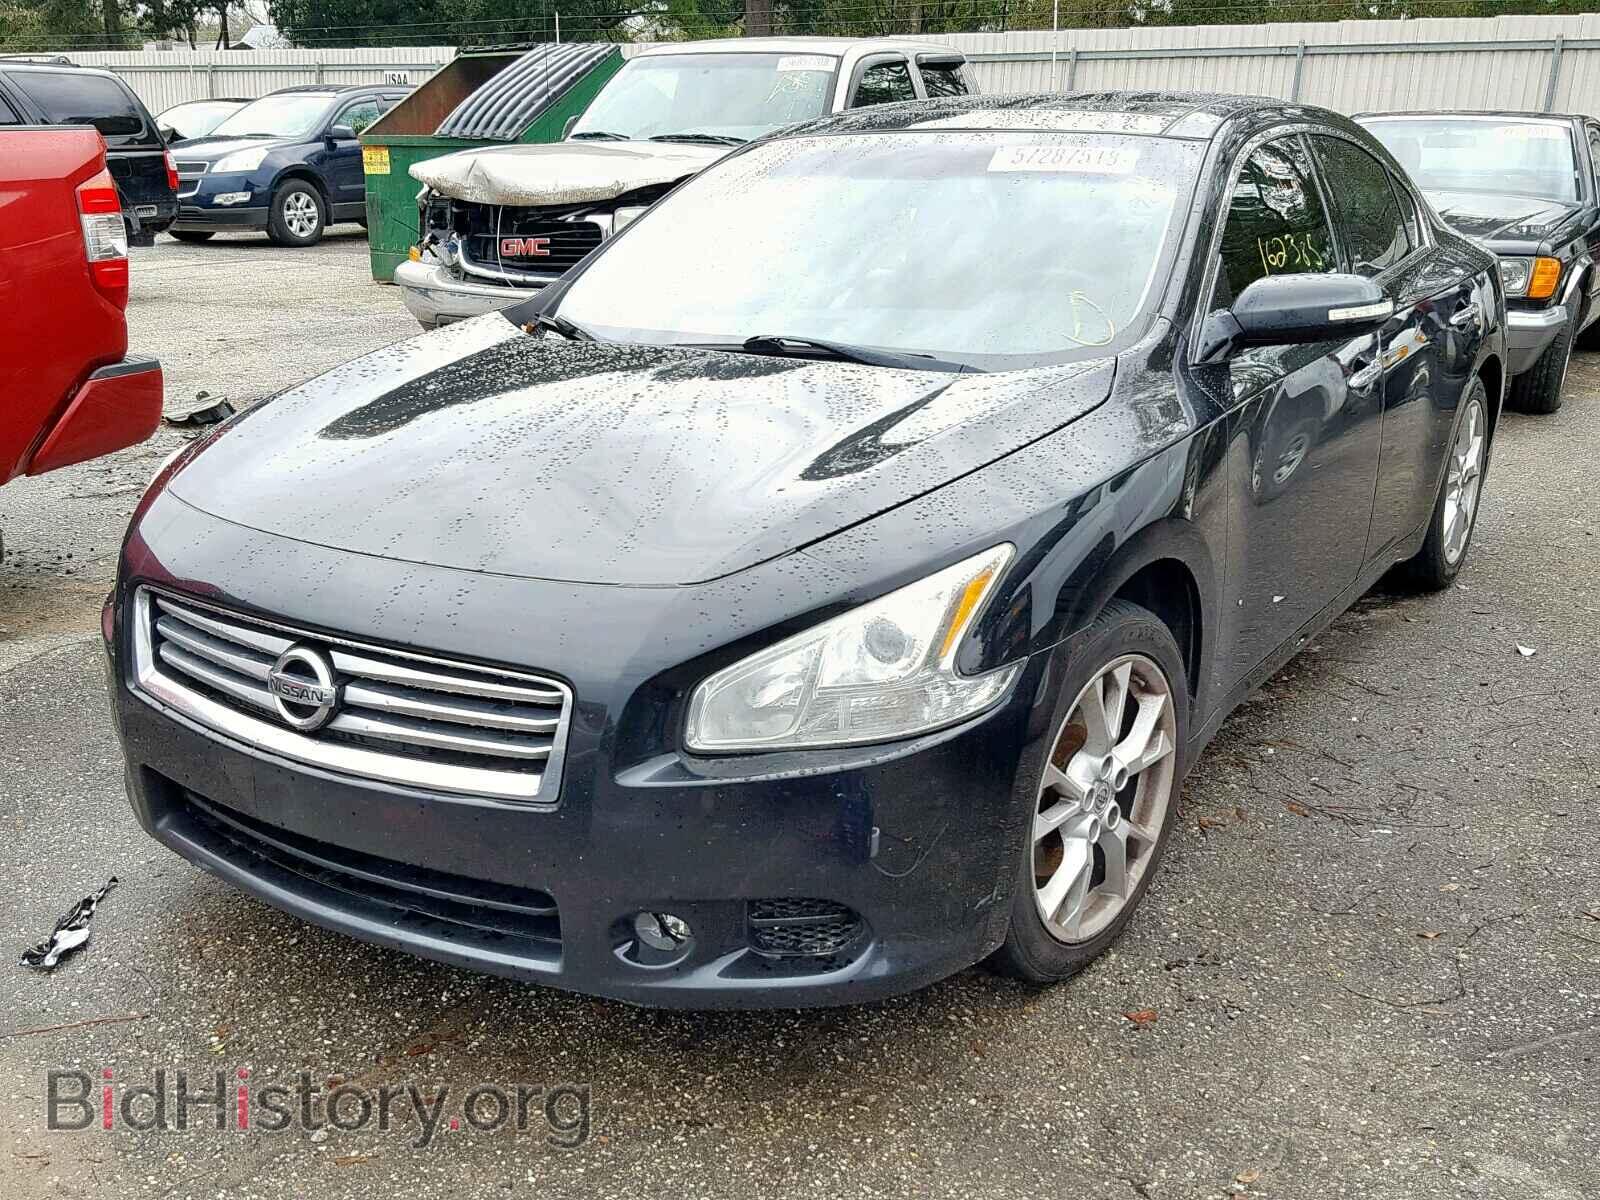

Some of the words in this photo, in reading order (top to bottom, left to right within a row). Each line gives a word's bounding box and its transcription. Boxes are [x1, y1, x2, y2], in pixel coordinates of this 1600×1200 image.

[385, 73, 408, 86] USAA
[501, 238, 550, 256] GMC
[271, 677, 324, 702] NISSAN
